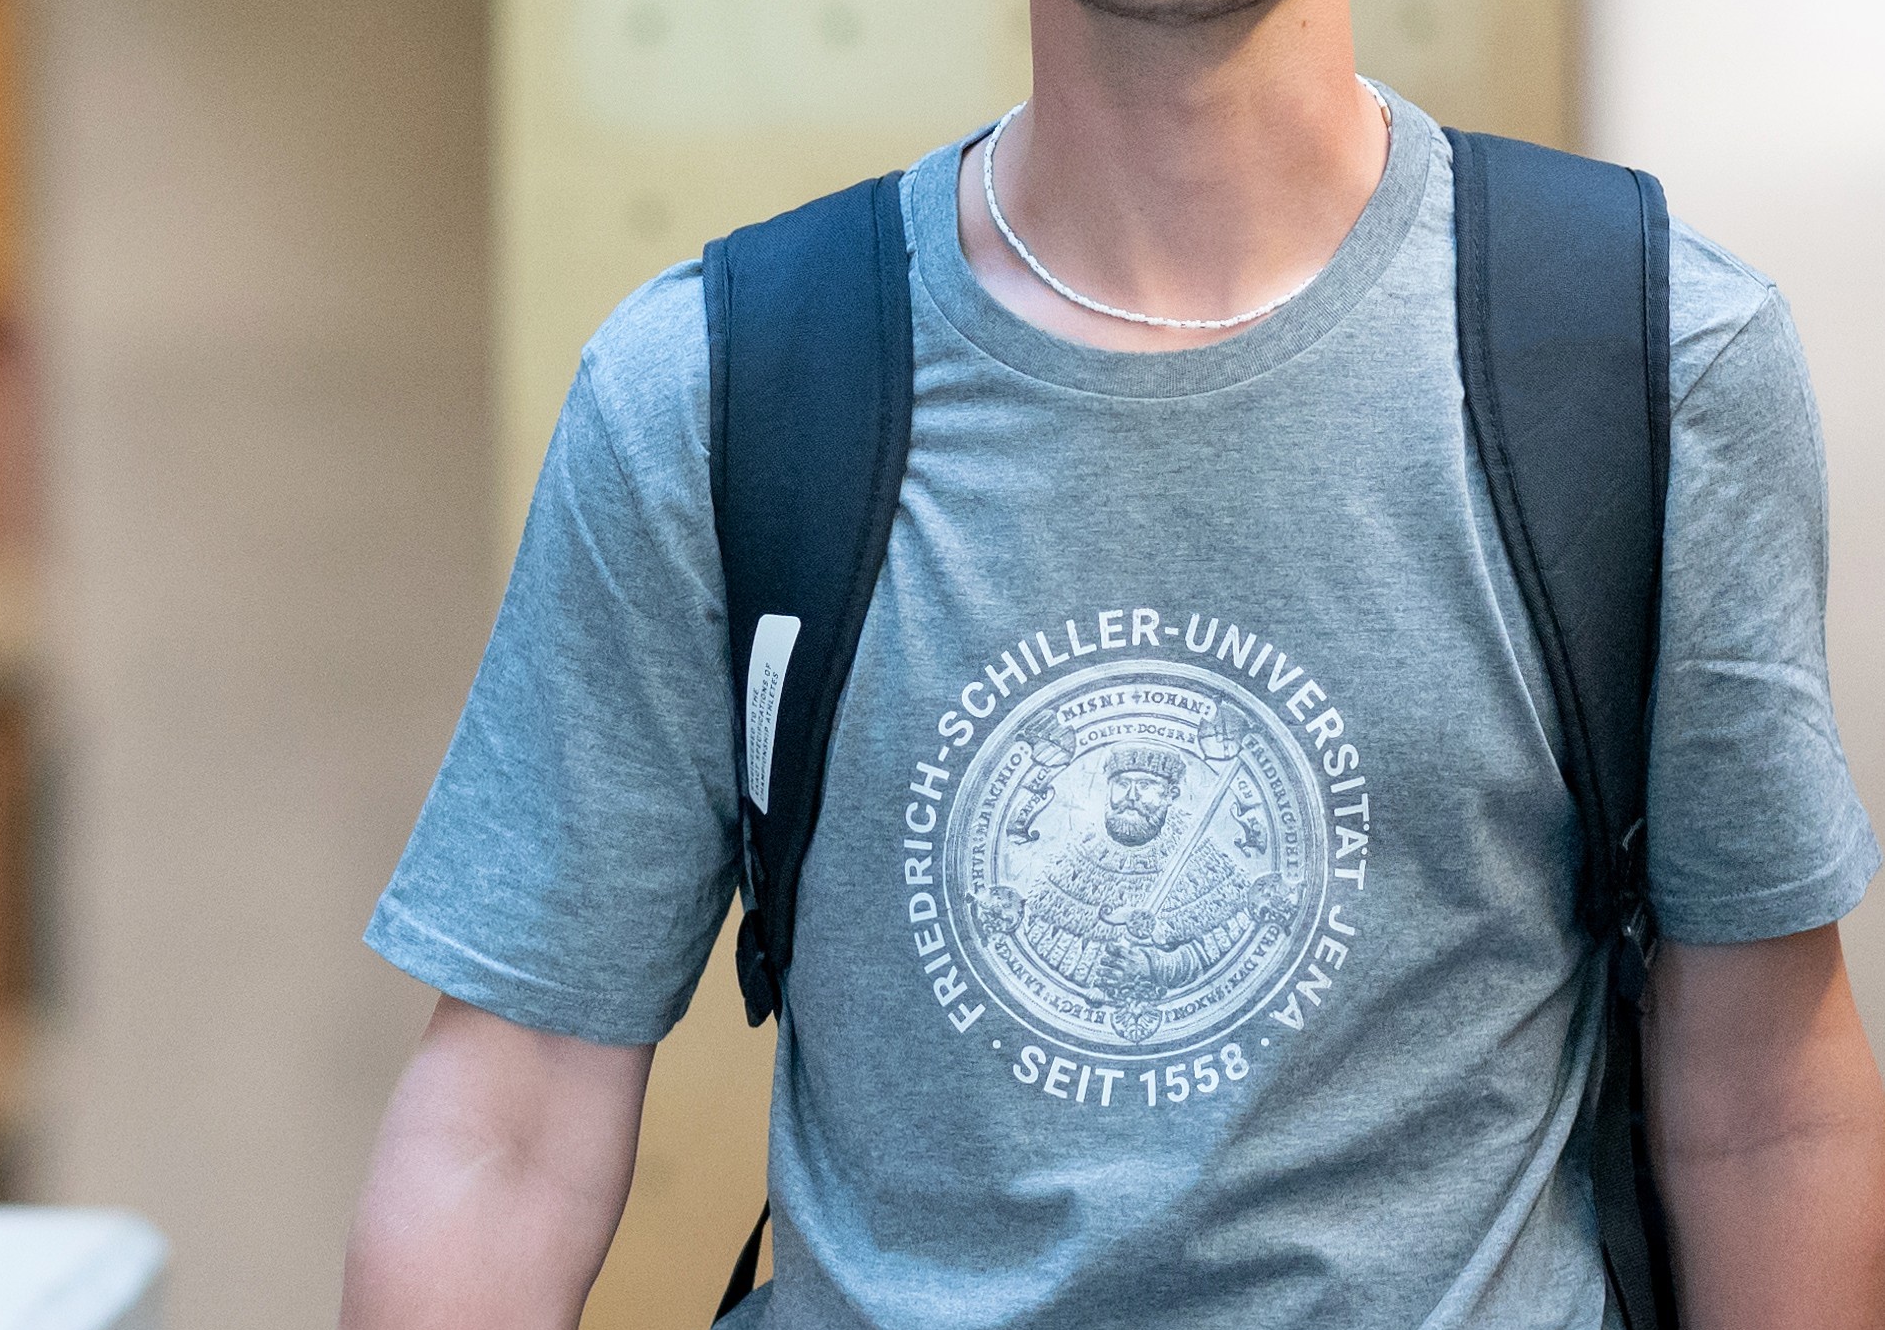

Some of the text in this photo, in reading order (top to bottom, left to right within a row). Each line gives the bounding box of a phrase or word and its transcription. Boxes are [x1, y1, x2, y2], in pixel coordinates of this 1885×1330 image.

[766, 671, 779, 724] ATHLETES
[903, 607, 1370, 1033] FRIEDRICH-SCHILLER-UNIVERSITÄT JENA
[1012, 1042, 1250, 1107] SEIT 1558
